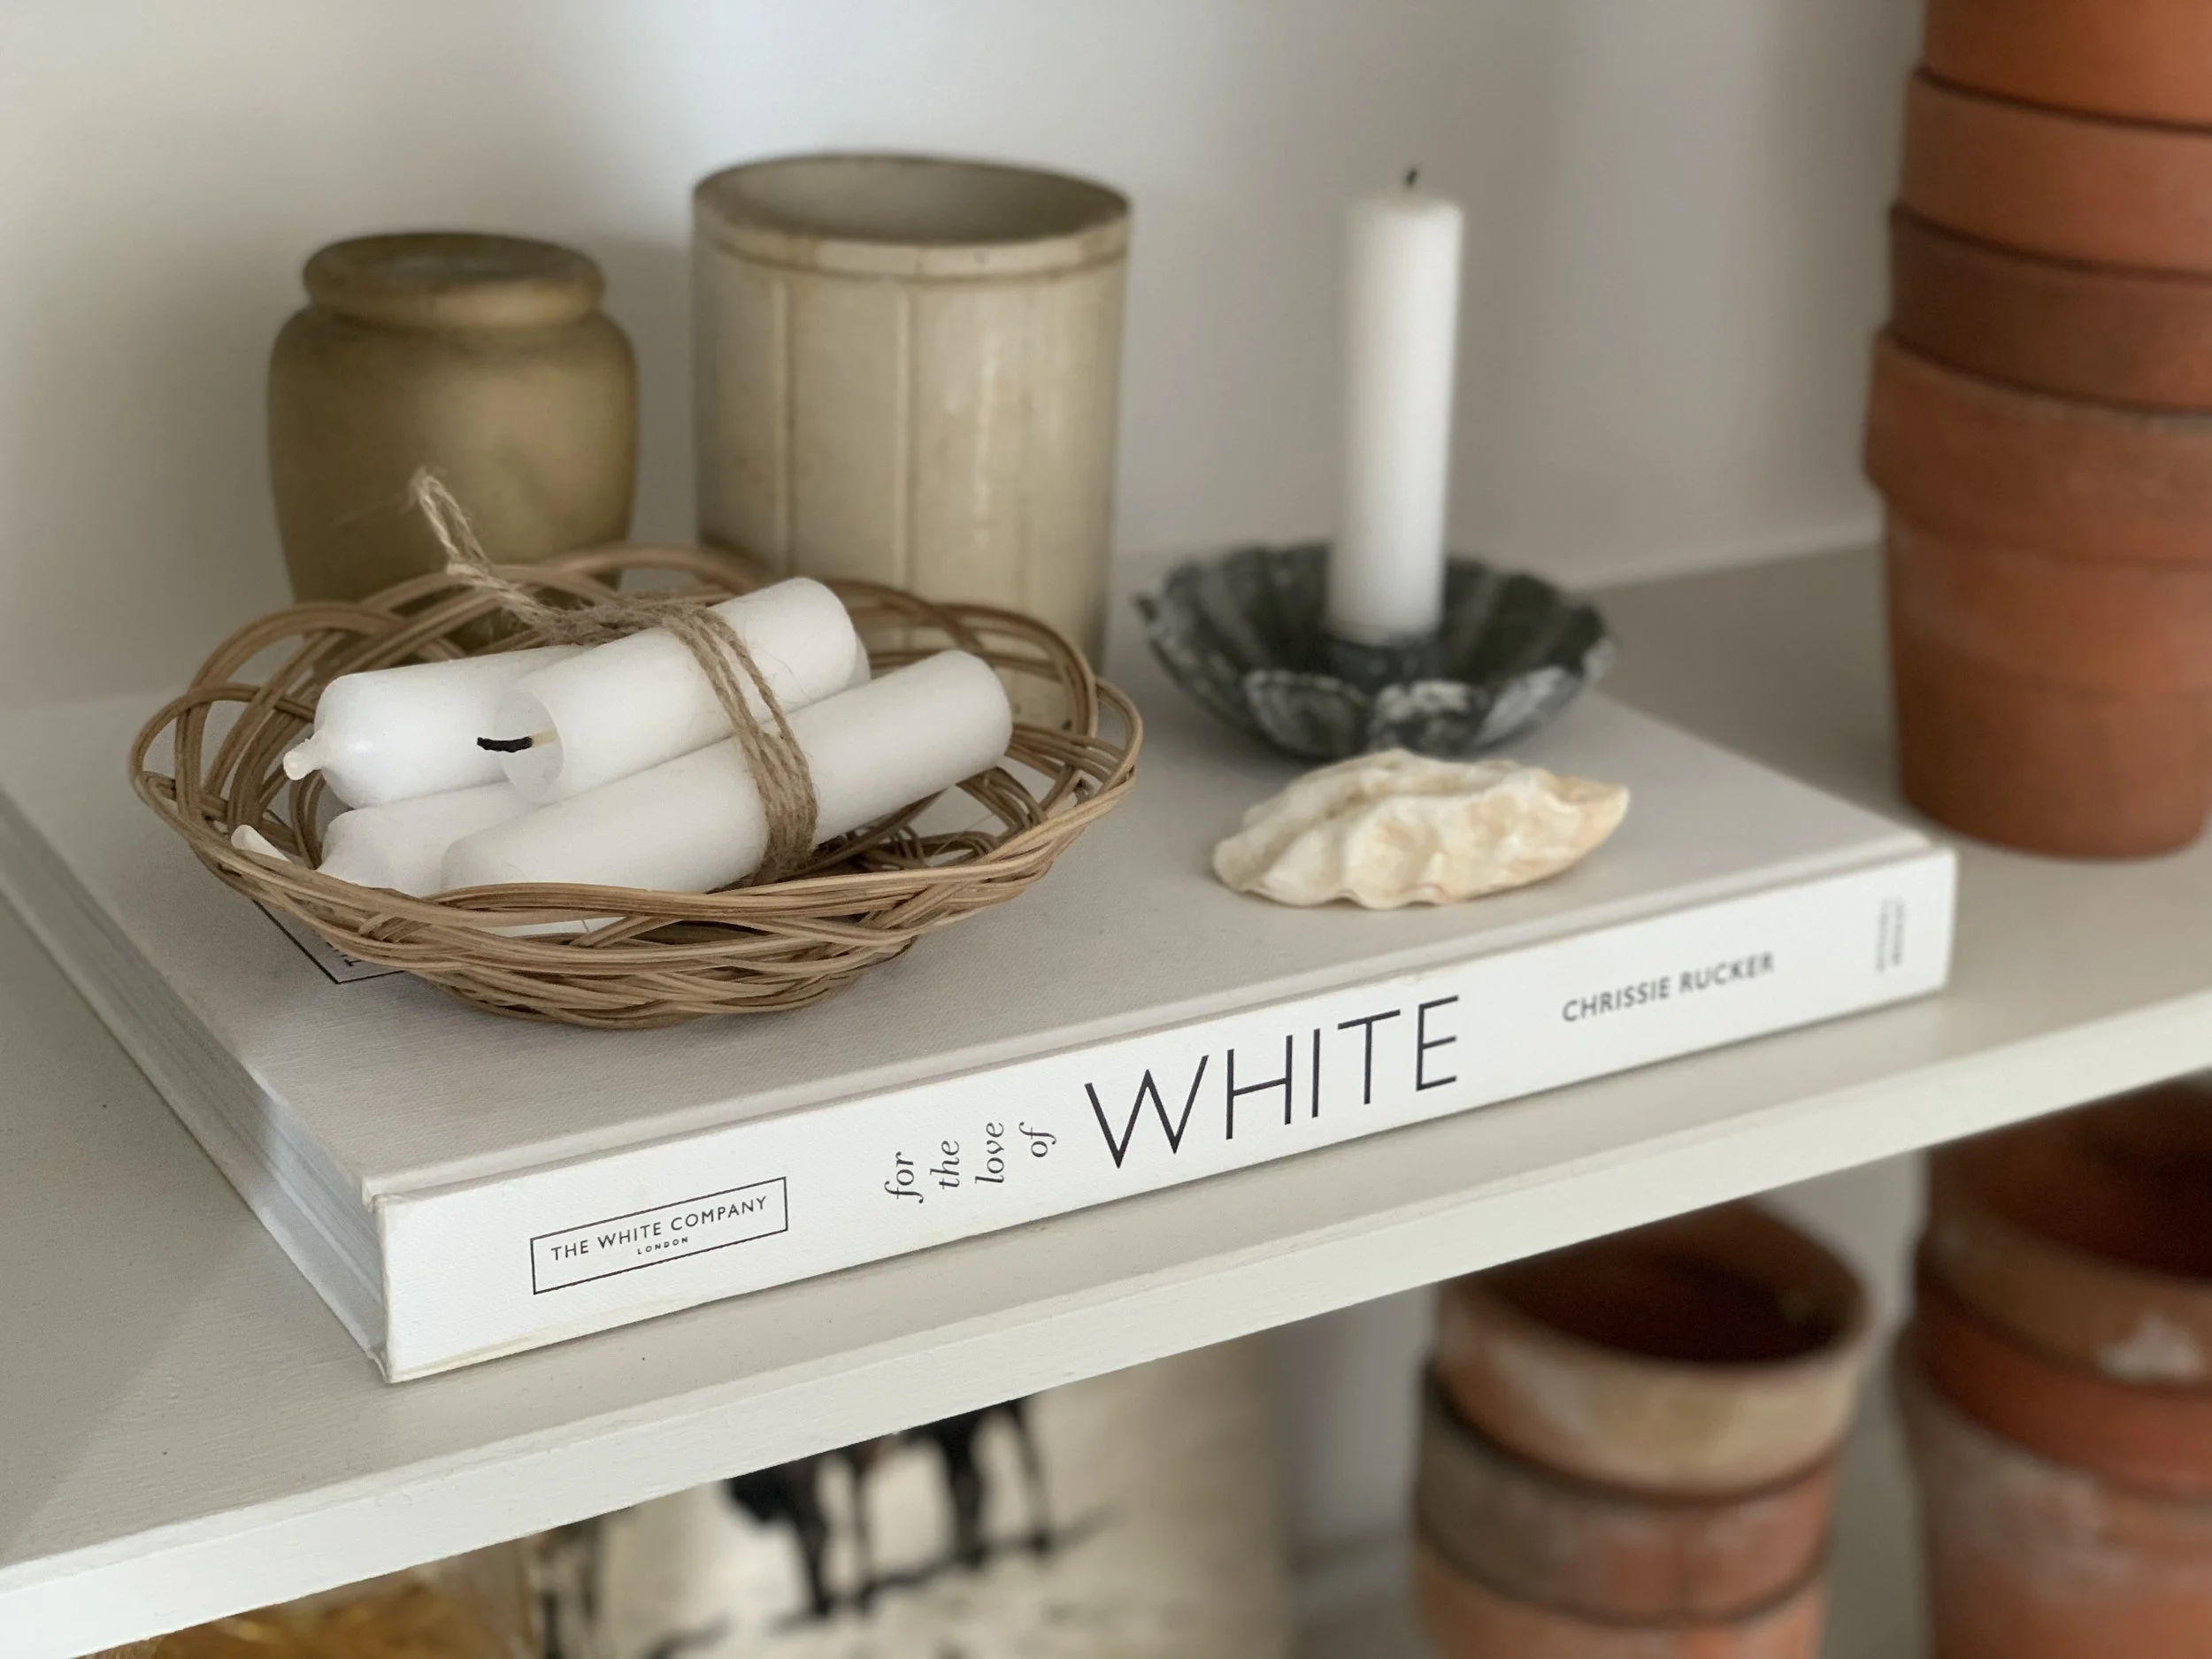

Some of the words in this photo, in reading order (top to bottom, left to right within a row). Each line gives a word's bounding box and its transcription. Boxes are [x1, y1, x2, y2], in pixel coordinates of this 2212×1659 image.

[1561, 976, 1671, 1023] CHRISSIE
[1678, 952, 1774, 994] RUCKER
[1085, 995, 1459, 1169] WHITE
[929, 1140, 961, 1189] the
[974, 1122, 1004, 1184] love
[1018, 1121, 1056, 1158] of
[884, 1151, 924, 1204] for
[550, 1239, 589, 1261] THE
[596, 1221, 663, 1249] WHITE
[670, 1195, 767, 1232] COMPANY
[637, 1236, 689, 1256] LONDON
